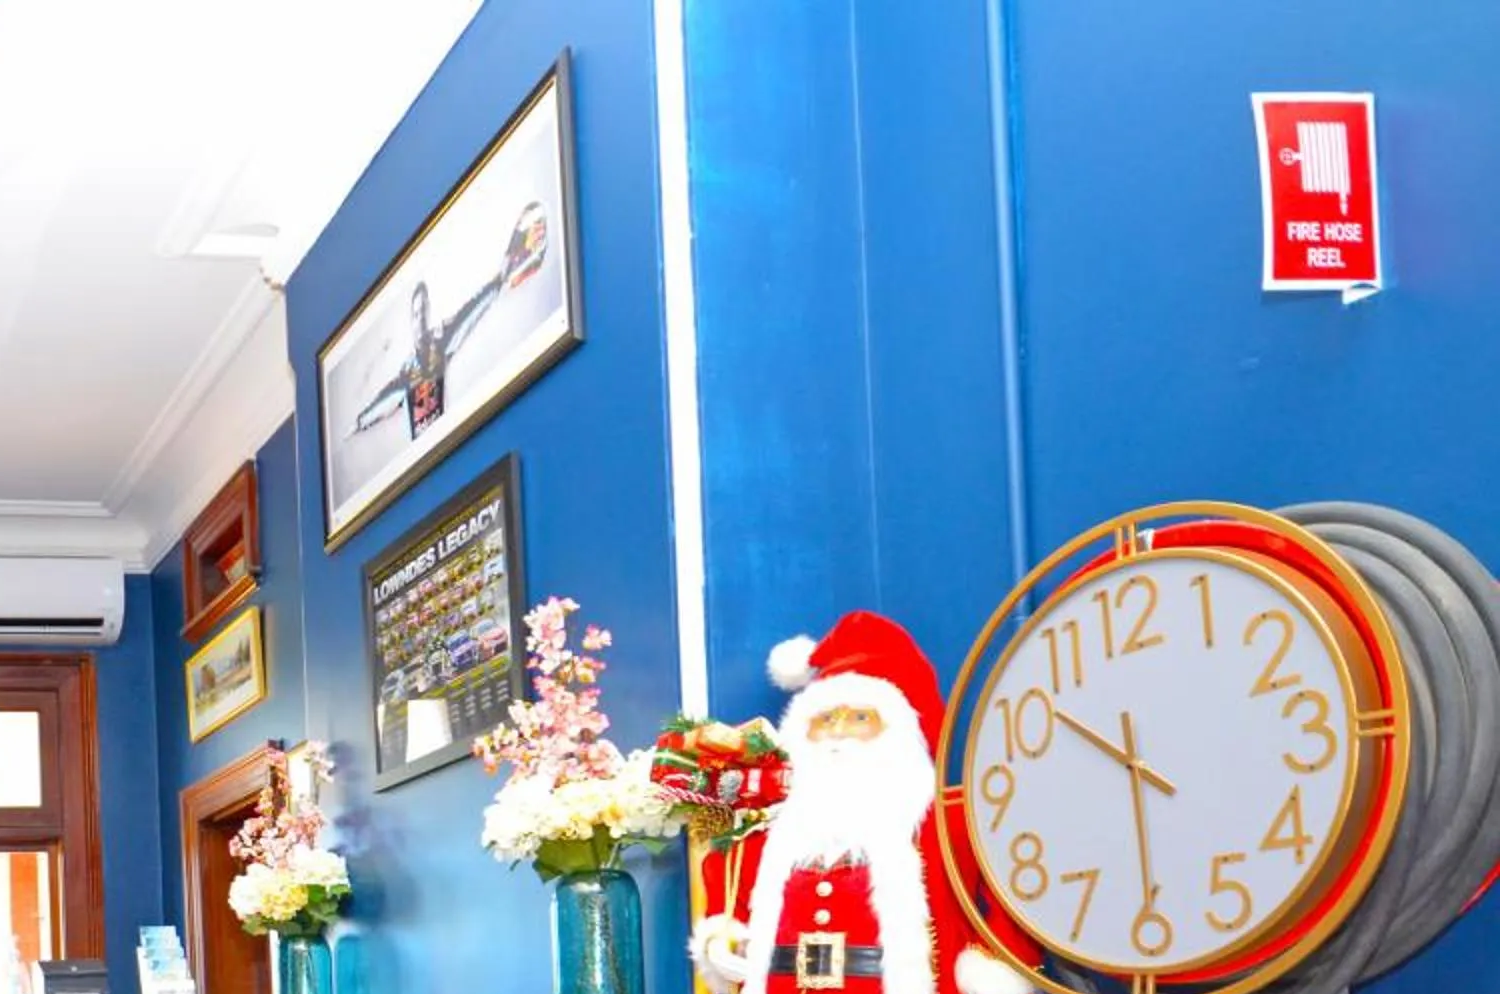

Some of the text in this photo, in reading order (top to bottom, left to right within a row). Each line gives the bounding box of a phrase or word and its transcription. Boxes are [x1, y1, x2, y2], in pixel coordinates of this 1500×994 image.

[1287, 222, 1363, 243] FIRE HOSE
[1307, 247, 1346, 268] REEL
[374, 547, 436, 603] LOWNDES
[438, 499, 501, 558] LEGACY
[1093, 574, 1164, 660] 12
[1189, 573, 1213, 648] 1
[1041, 619, 1082, 695] 11
[1243, 610, 1301, 697] 2
[994, 687, 1054, 763] 10
[1281, 690, 1338, 774] 3
[980, 763, 1015, 833] 9
[1259, 785, 1313, 865] 4
[1009, 832, 1049, 902] 8
[1060, 868, 1100, 942] 7
[1205, 852, 1252, 932] 5
[1131, 884, 1173, 957] 6
